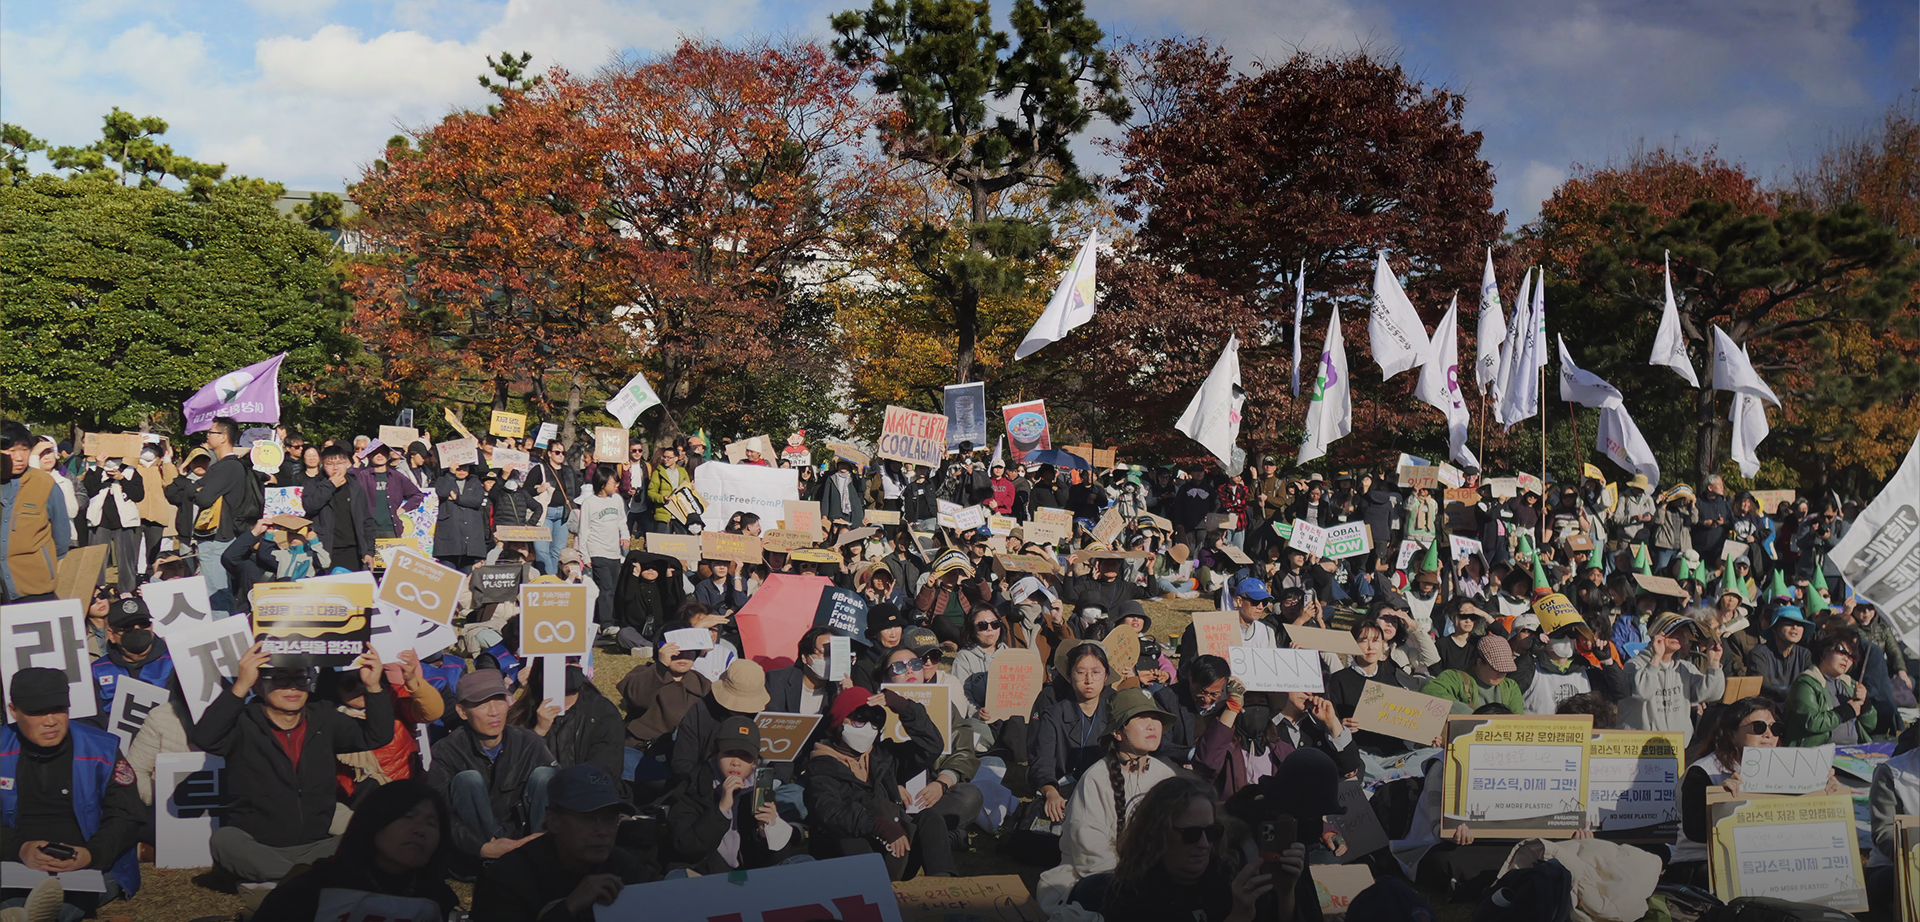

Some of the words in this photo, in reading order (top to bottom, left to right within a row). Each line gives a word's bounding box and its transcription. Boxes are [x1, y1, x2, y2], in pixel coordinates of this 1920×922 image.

[885, 409, 918, 437] MAKE
[918, 415, 947, 442] EARTH
[1327, 526, 1360, 539] LOBAL
[1325, 539, 1361, 557] NOW
[398, 555, 412, 569] 12
[495, 572, 516, 580] MORE
[482, 580, 516, 588] PLASTIC
[527, 591, 540, 607] 12
[542, 591, 571, 599] 지속가능한
[832, 592, 864, 610] #Break
[1539, 599, 1557, 611] Cut
[258, 605, 290, 616] 일회용
[317, 605, 348, 617] 다회용
[834, 601, 856, 615] Free
[831, 609, 857, 624] From
[828, 618, 860, 635] Plastic
[327, 640, 363, 655] 멈추자
[758, 717, 773, 729] 12
[1378, 711, 1419, 730] PLASTIC
[1475, 731, 1512, 742] 플라스틱
[1516, 731, 1534, 742] 저감
[1538, 732, 1584, 743] 문화캠페인
[1590, 745, 1621, 755] 플라스틱
[1623, 745, 1639, 755] 저감
[1642, 745, 1678, 756] 문화캠페인
[1565, 759, 1576, 772] 는
[1665, 771, 1674, 783] 는
[1550, 778, 1577, 791] 그만!
[1654, 789, 1675, 801] 그만!
[1736, 811, 1774, 824] 플라스틱
[1777, 810, 1795, 821] 저감
[1799, 807, 1846, 820] 문화캠페인
[1832, 836, 1845, 848] 는
[1822, 855, 1849, 869] 그만!
[1800, 883, 1829, 891] PLASTIC!
